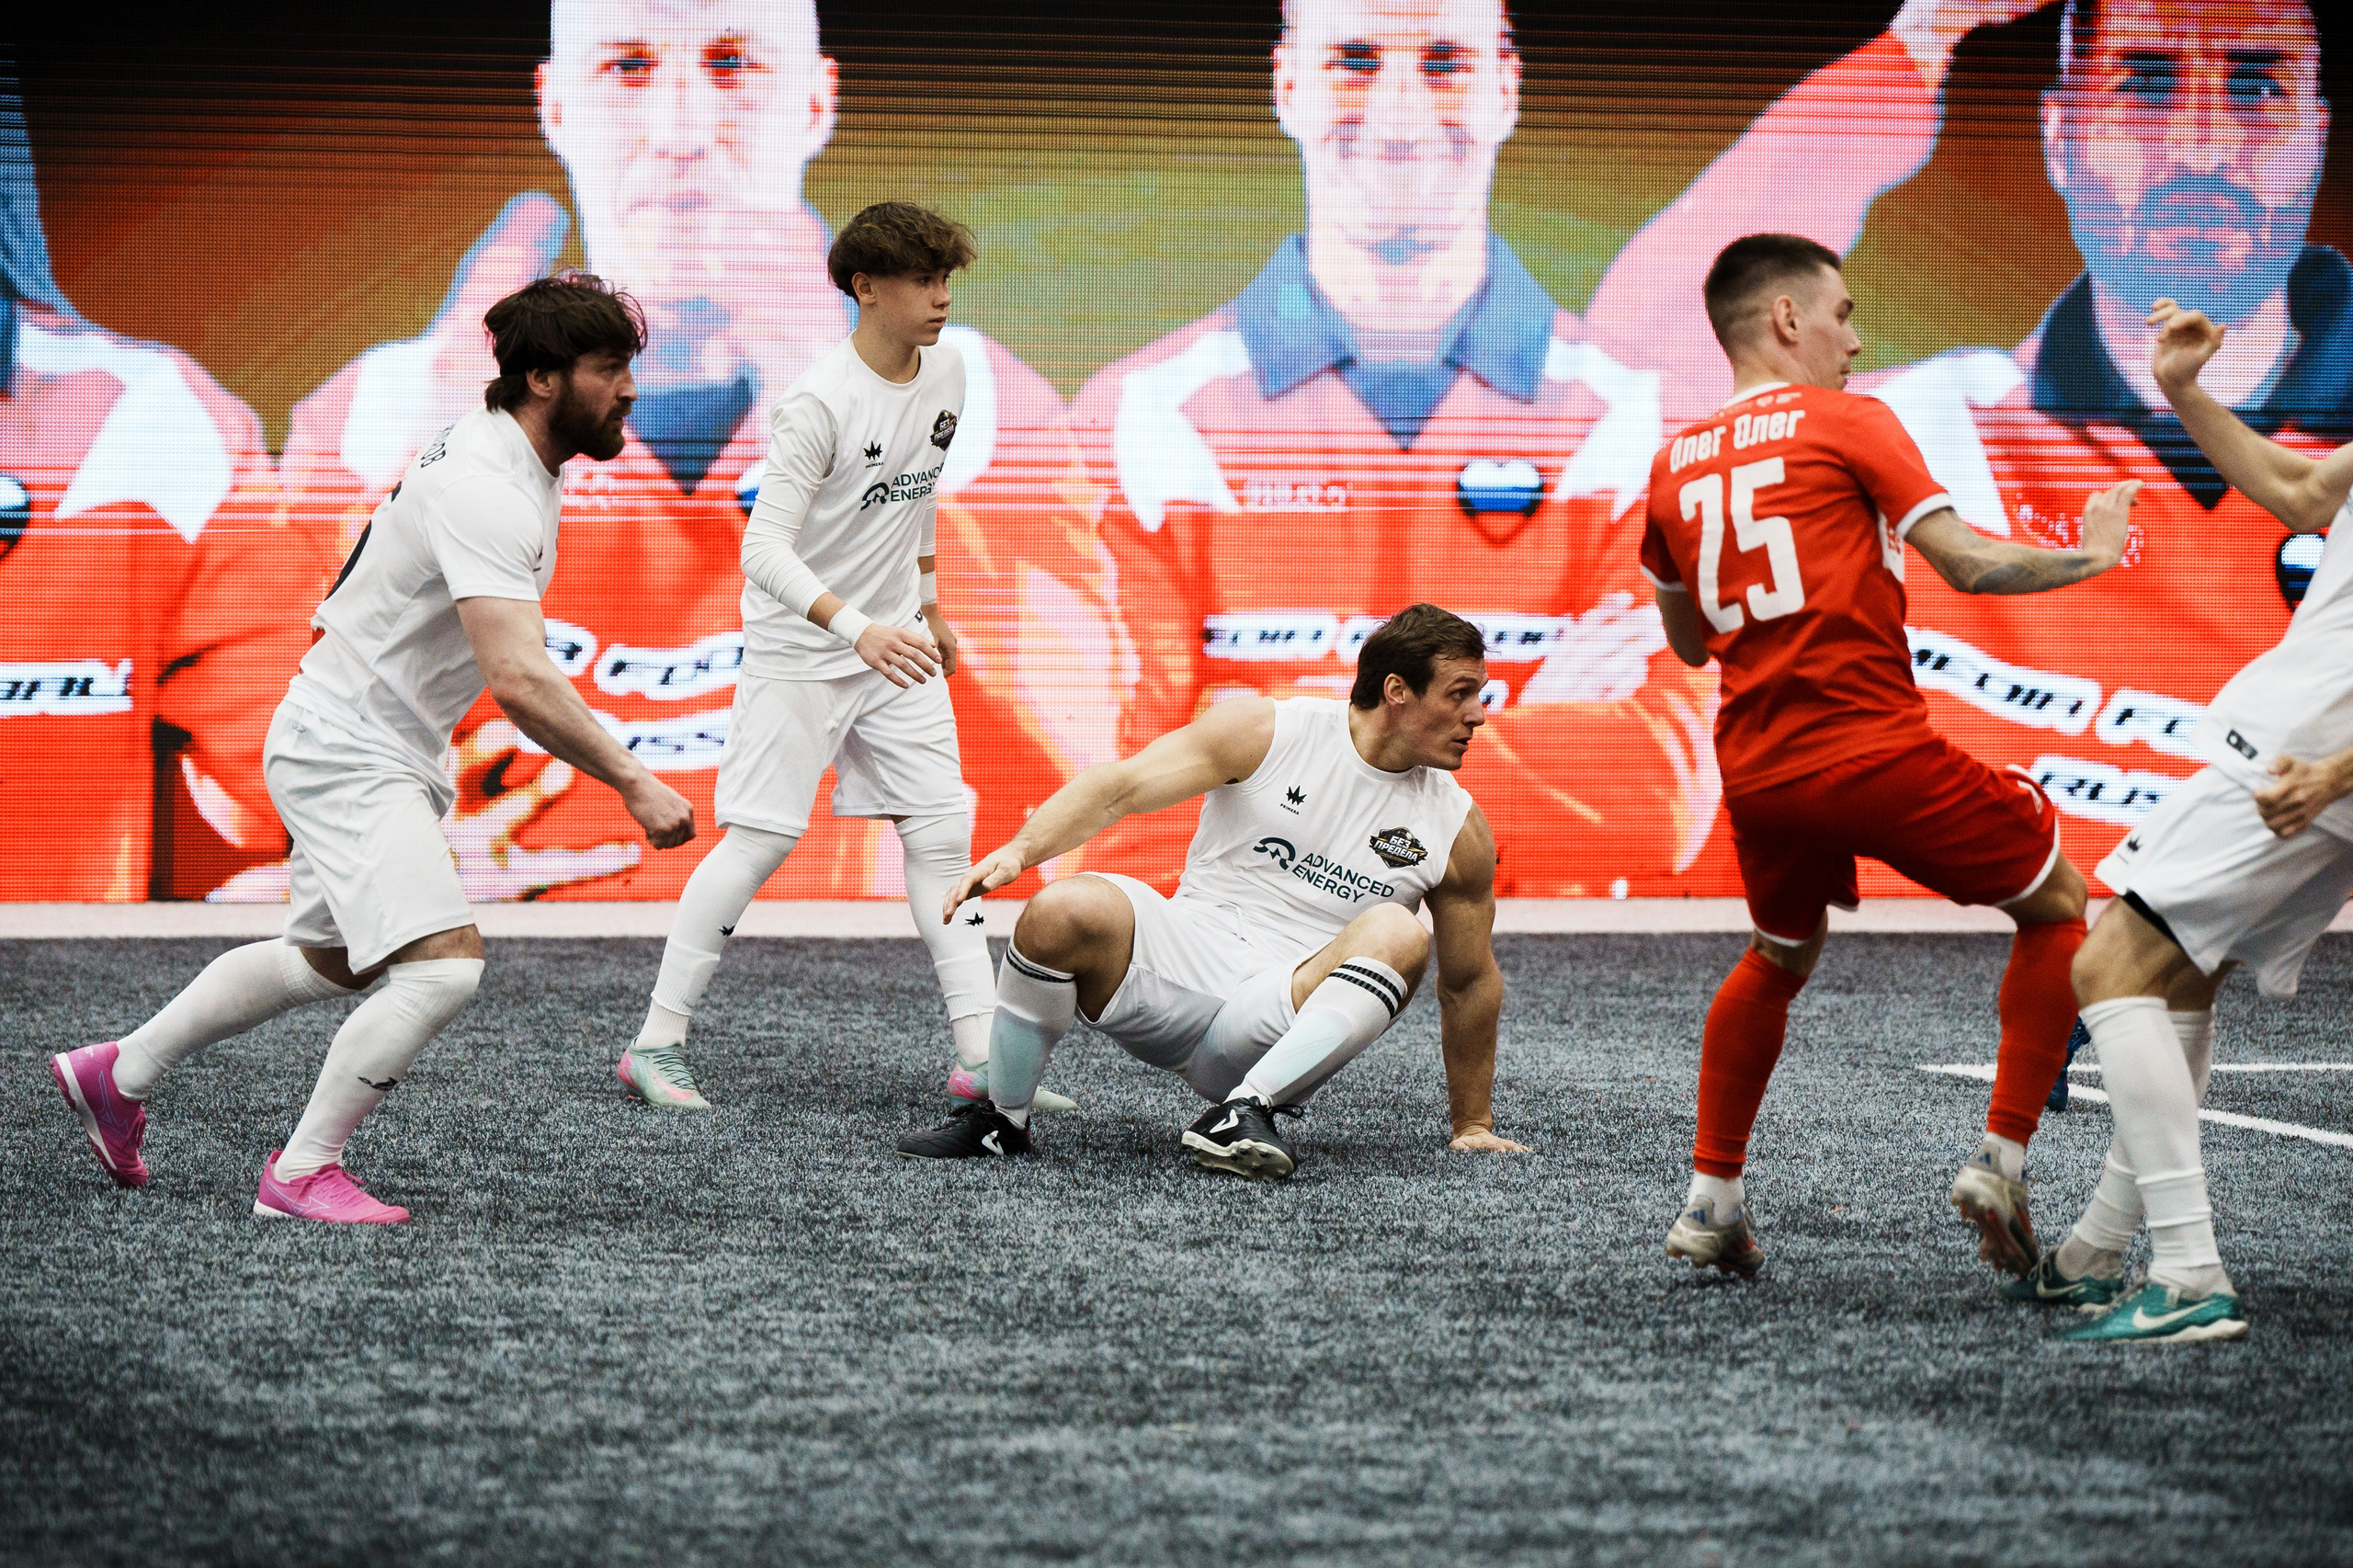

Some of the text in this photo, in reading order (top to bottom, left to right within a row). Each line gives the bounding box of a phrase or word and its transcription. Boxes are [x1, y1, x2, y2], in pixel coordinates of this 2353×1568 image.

[1733, 410, 1806, 449] Олег
[890, 481, 936, 503] ENERG
[1678, 455, 1806, 635] 25
[1373, 839, 1419, 862] ПРЕДЕЛА
[1389, 835, 1412, 849] БЕЗ
[1291, 864, 1366, 903] ENERGY
[1301, 852, 1395, 898] ADVANCED
